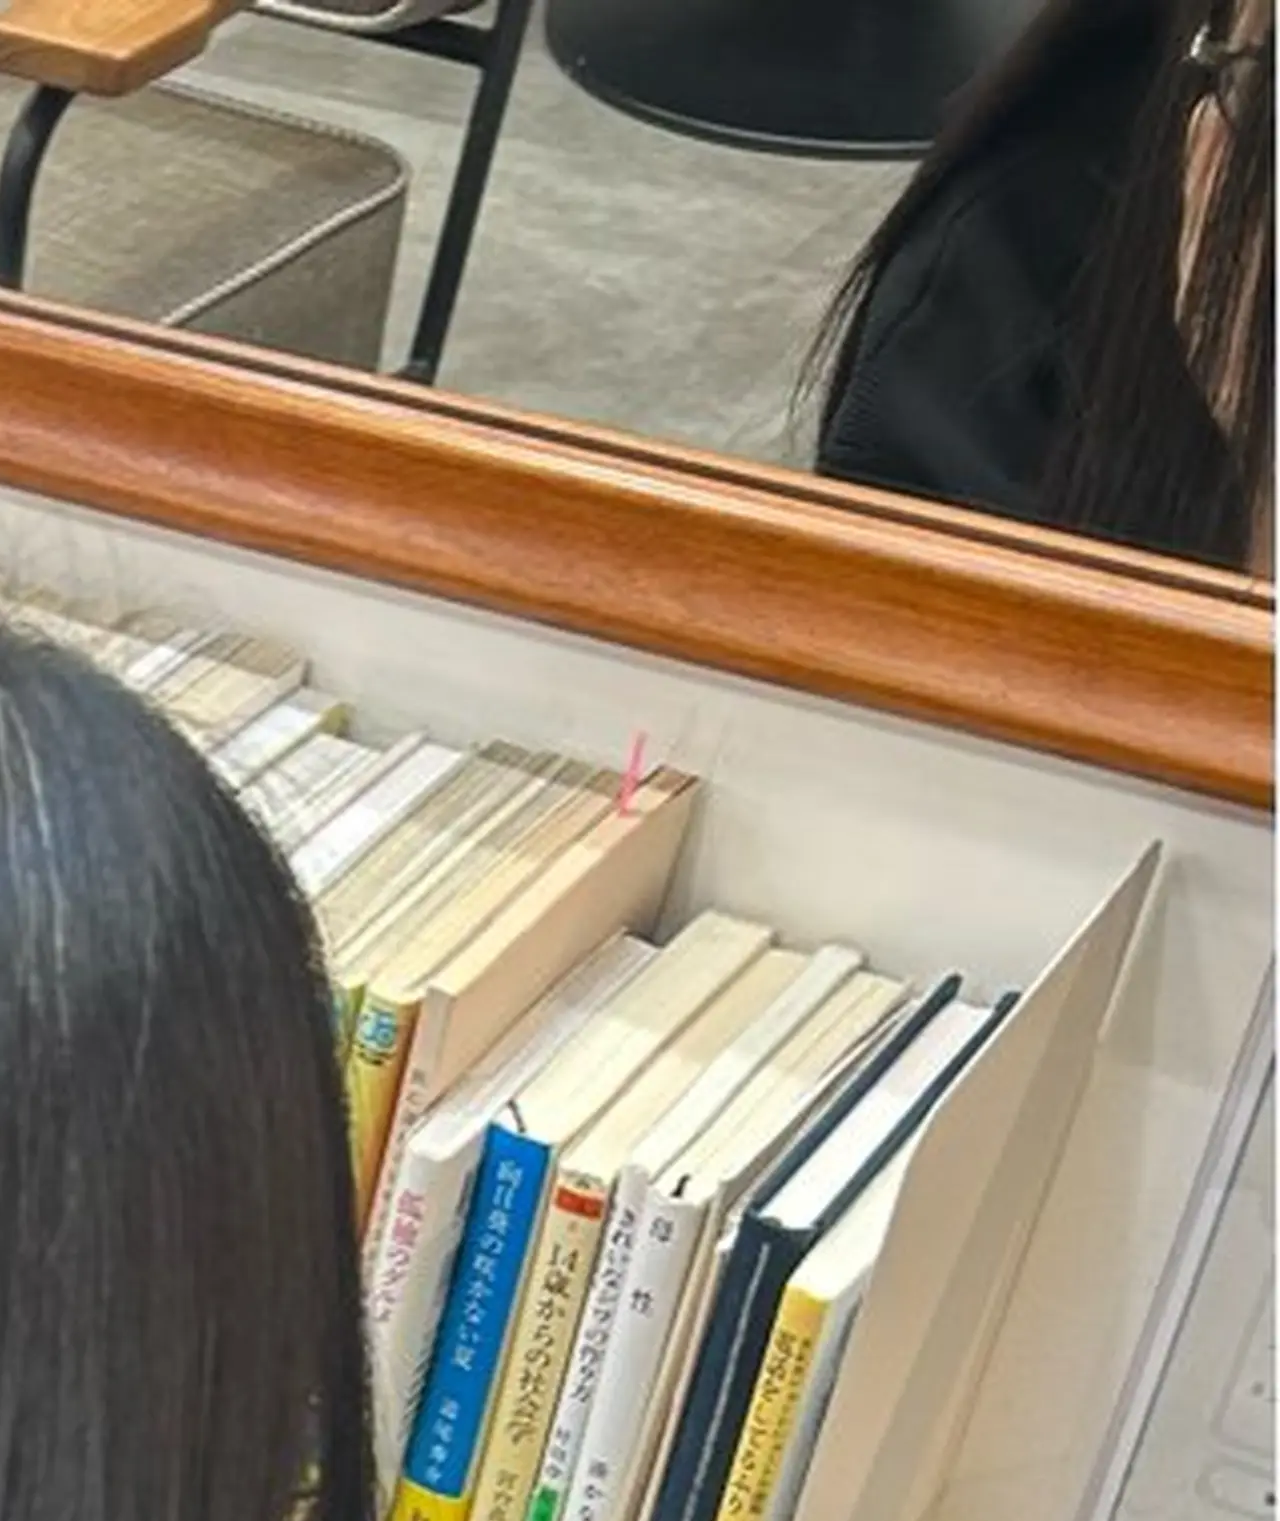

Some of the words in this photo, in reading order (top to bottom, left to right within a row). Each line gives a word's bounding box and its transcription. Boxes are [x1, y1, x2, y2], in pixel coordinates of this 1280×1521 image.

[451, 1159, 523, 1372] 向日葵の咲かない夏
[503, 1242, 579, 1446] 14歳からの社会学
